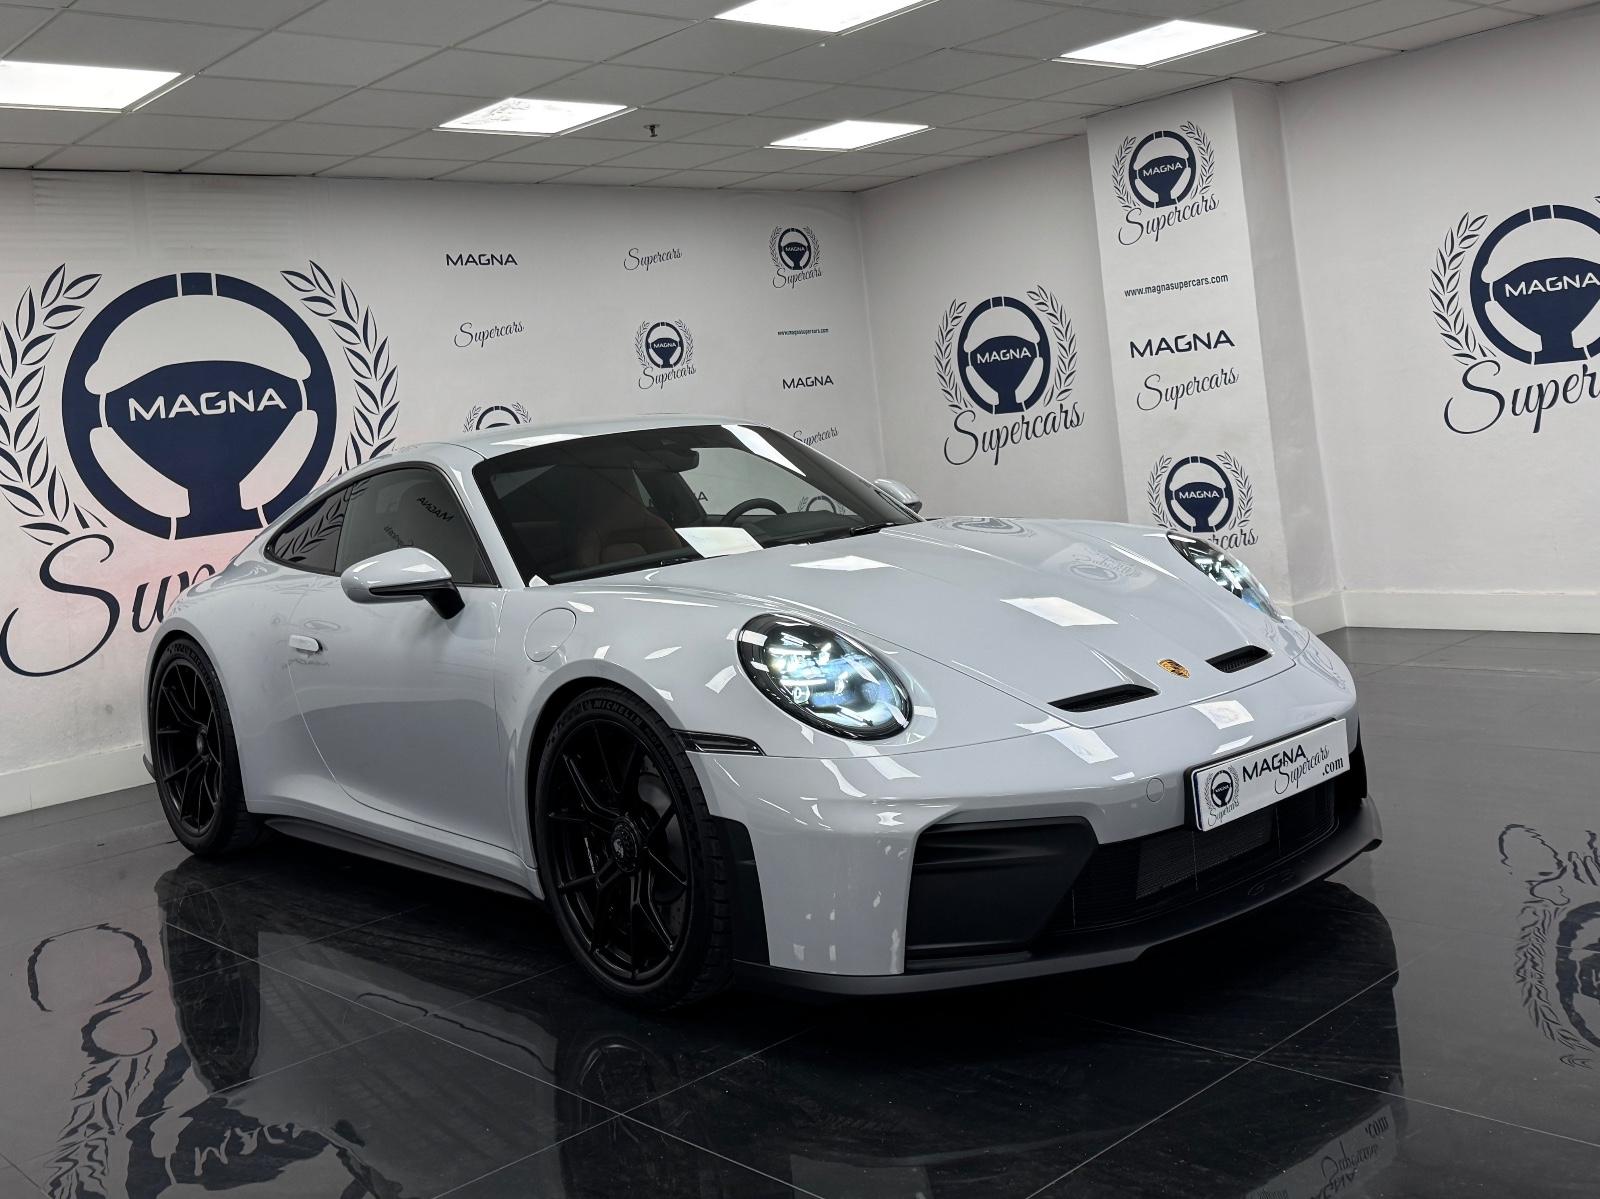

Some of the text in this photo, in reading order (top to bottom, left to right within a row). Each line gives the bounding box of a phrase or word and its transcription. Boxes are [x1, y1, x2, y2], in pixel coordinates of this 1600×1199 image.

[1142, 160, 1184, 179] MAGNA
[1117, 192, 1220, 246] Supercars
[445, 253, 518, 267] MAGNA
[623, 247, 683, 272] Supercars
[784, 245, 806, 253] MAGNA
[772, 266, 822, 289] Supercars
[1124, 273, 1229, 298] www.magnasupercars.com
[1504, 271, 1600, 298] MAGNA
[453, 321, 525, 348] Supercars
[653, 341, 677, 350] MAGNA
[1130, 329, 1236, 359] MAGNA
[976, 344, 1032, 365] MAGNA
[638, 362, 697, 390] Supercars
[782, 374, 834, 390] MAGNA
[1136, 366, 1240, 411] Supercars
[127, 387, 287, 422] MAGNA
[944, 400, 1086, 466] Supercars
[1178, 488, 1221, 500] MAGNA
[1242, 744, 1307, 783] MAGNA
[1274, 744, 1330, 795] Supercars
[1321, 756, 1344, 777] .com
